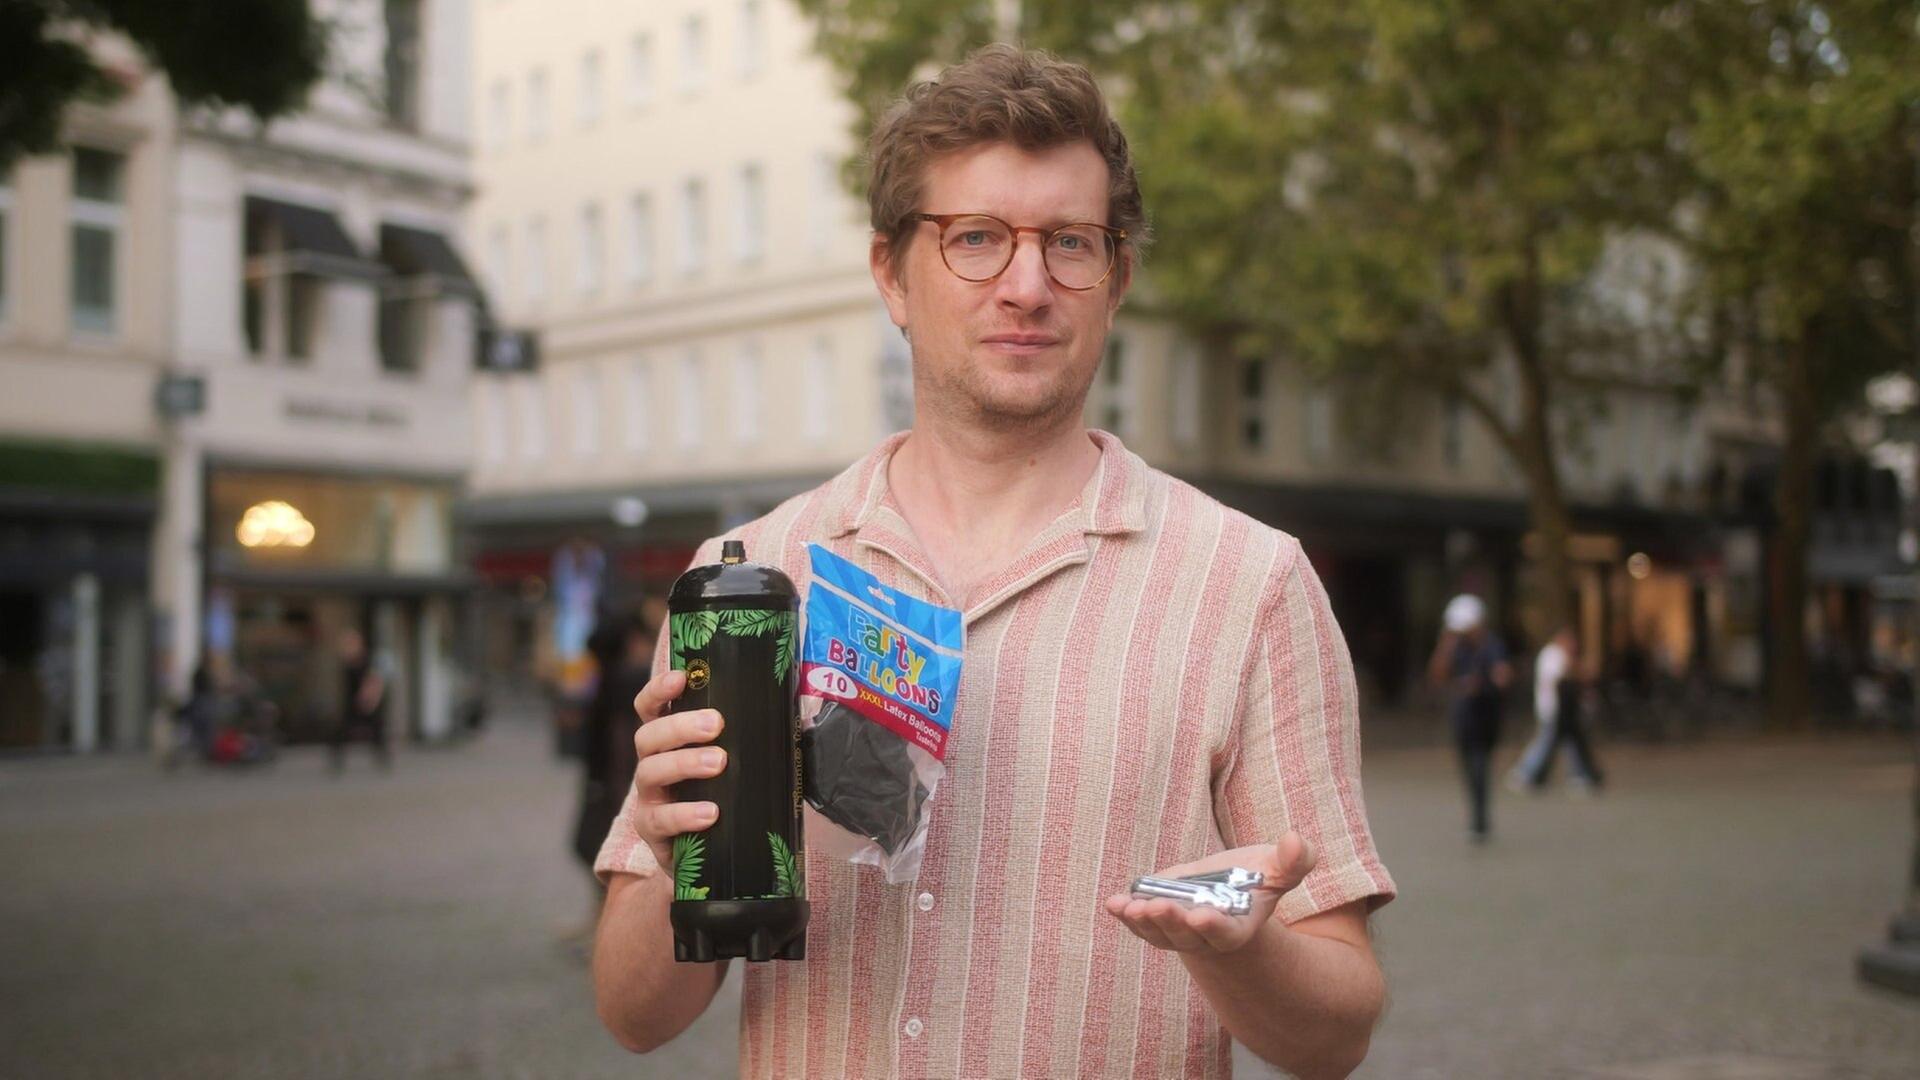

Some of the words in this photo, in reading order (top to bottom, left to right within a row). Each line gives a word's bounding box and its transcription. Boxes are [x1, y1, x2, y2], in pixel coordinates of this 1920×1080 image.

[848, 604, 926, 685] Party
[823, 672, 847, 693] 10
[860, 688, 883, 709] XXXL
[883, 701, 907, 721] Latex
[908, 715, 942, 743] Balloons
